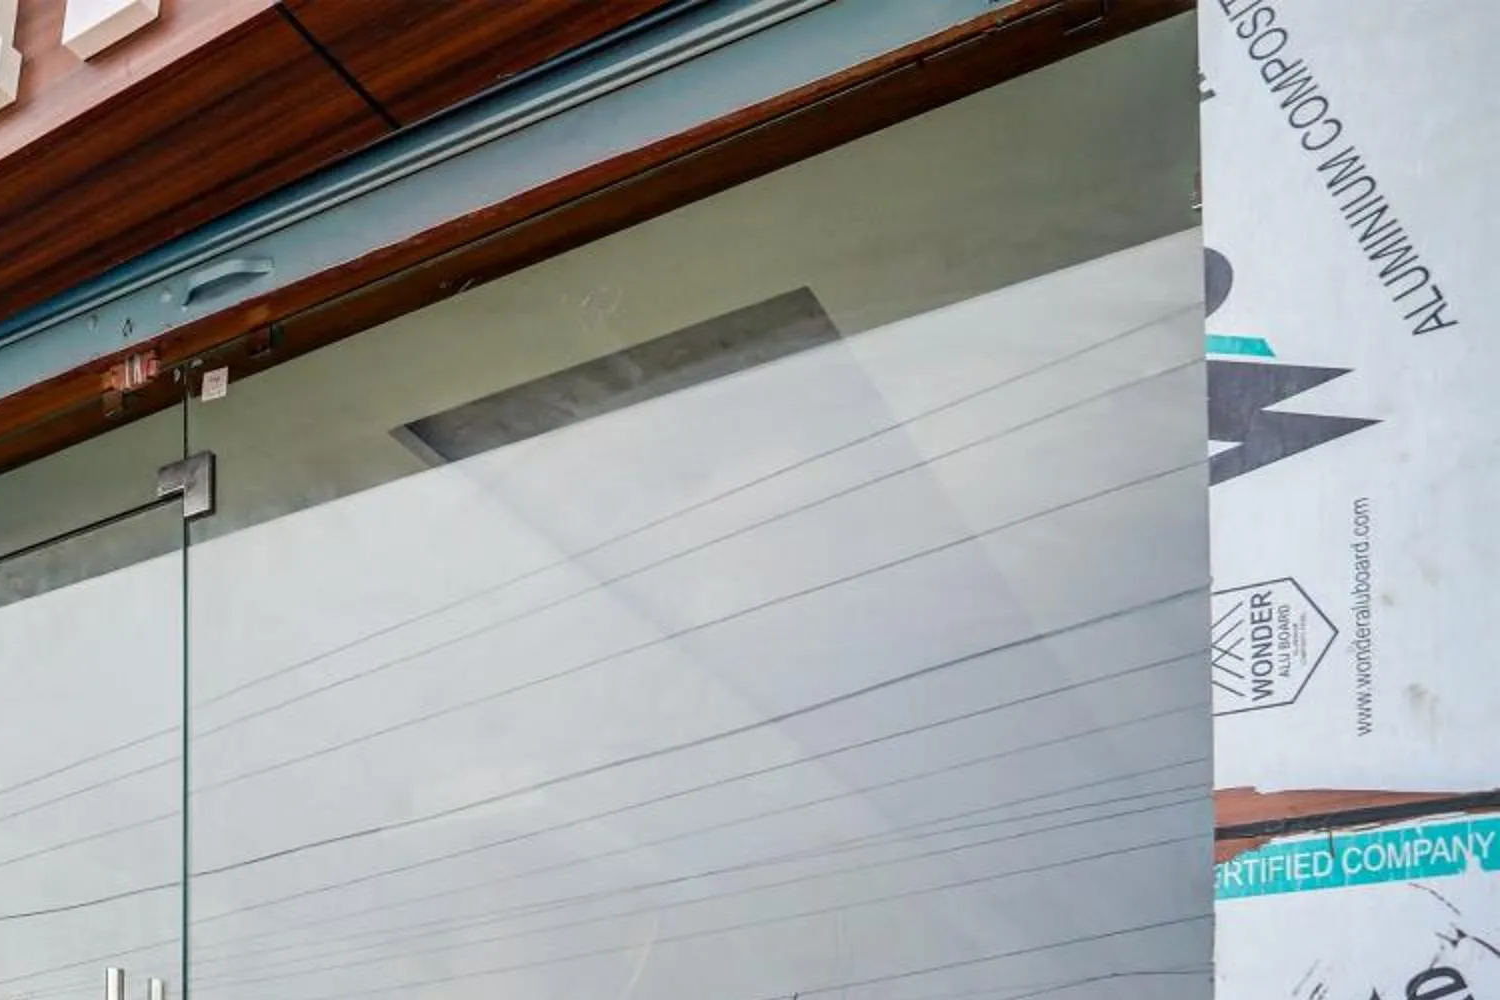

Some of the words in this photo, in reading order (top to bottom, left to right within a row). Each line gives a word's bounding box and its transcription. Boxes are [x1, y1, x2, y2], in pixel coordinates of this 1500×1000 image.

[1316, 145, 1459, 336] ALUMINIUM
[1250, 590, 1274, 701] WONDER
[1276, 604, 1291, 651] BOARD
[1350, 497, 1373, 738] www.wonderaluboard.com
[1276, 653, 1292, 678] ALU
[1341, 831, 1497, 875] COMPANY
